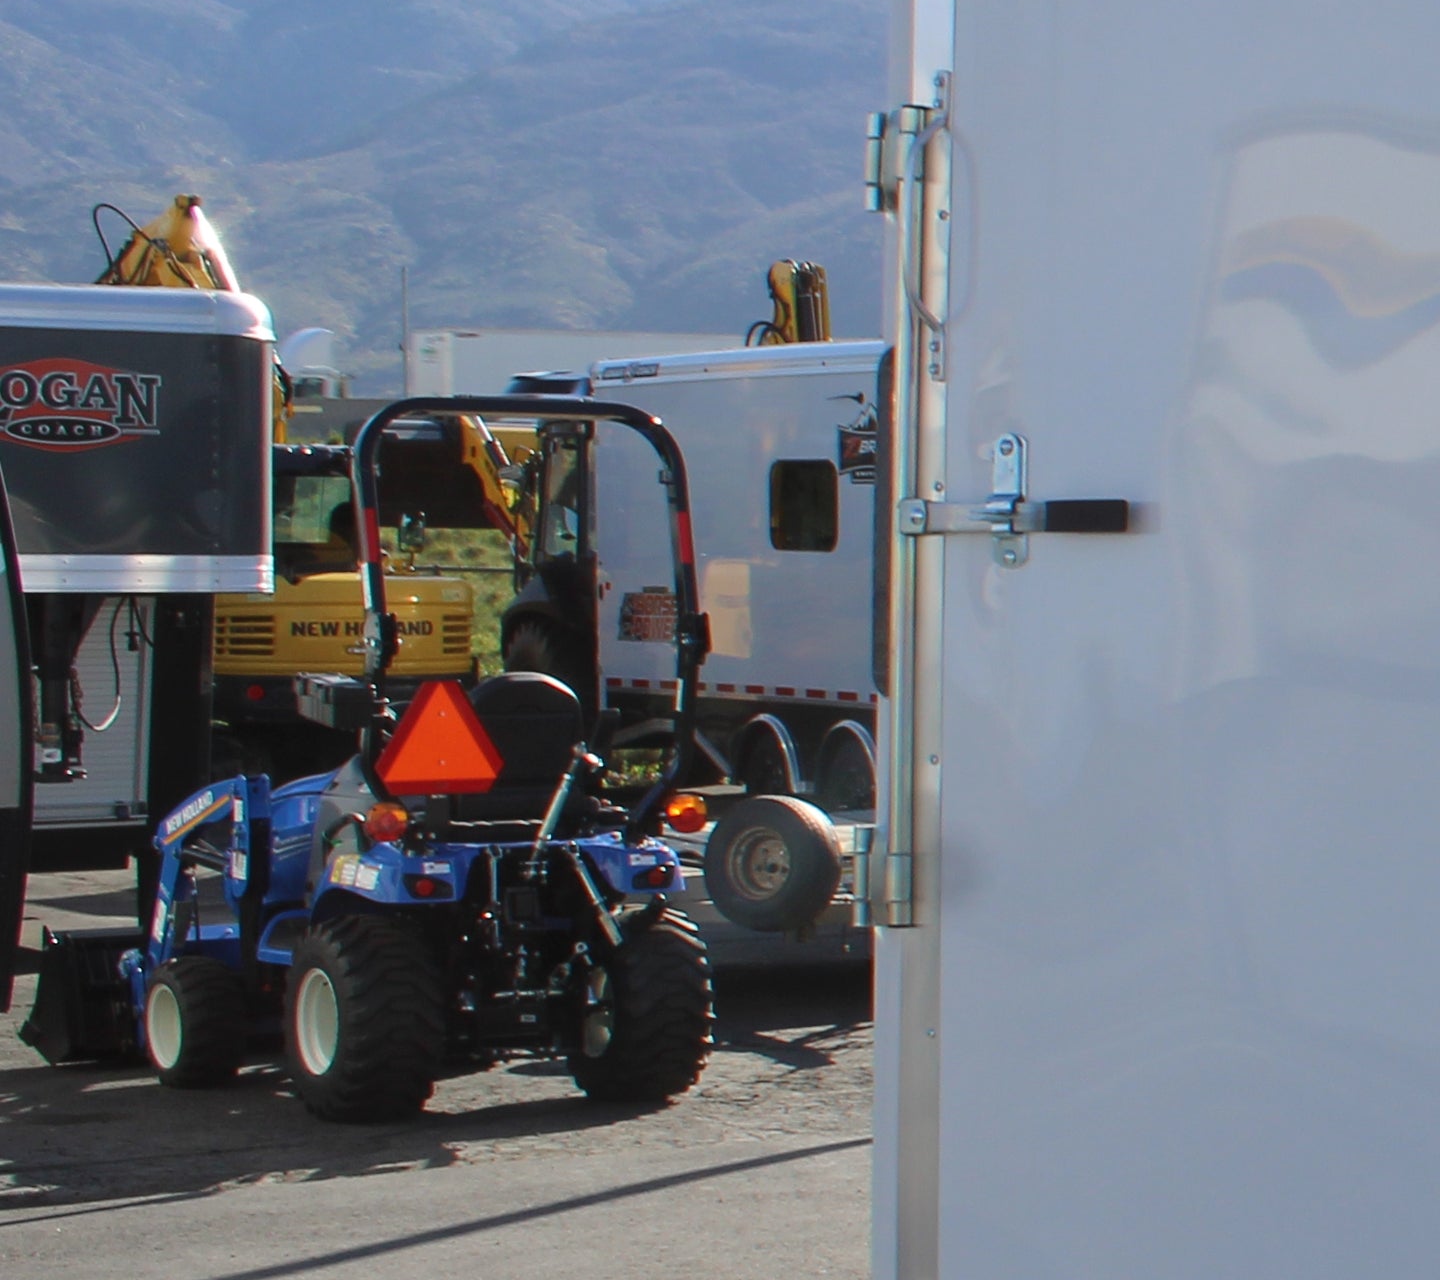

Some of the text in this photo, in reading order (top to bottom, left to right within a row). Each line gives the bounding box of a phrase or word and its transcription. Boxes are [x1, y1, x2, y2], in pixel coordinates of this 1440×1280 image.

[0, 369, 161, 426] OGAN
[20, 424, 103, 436] COACH
[291, 622, 339, 637] NEW
